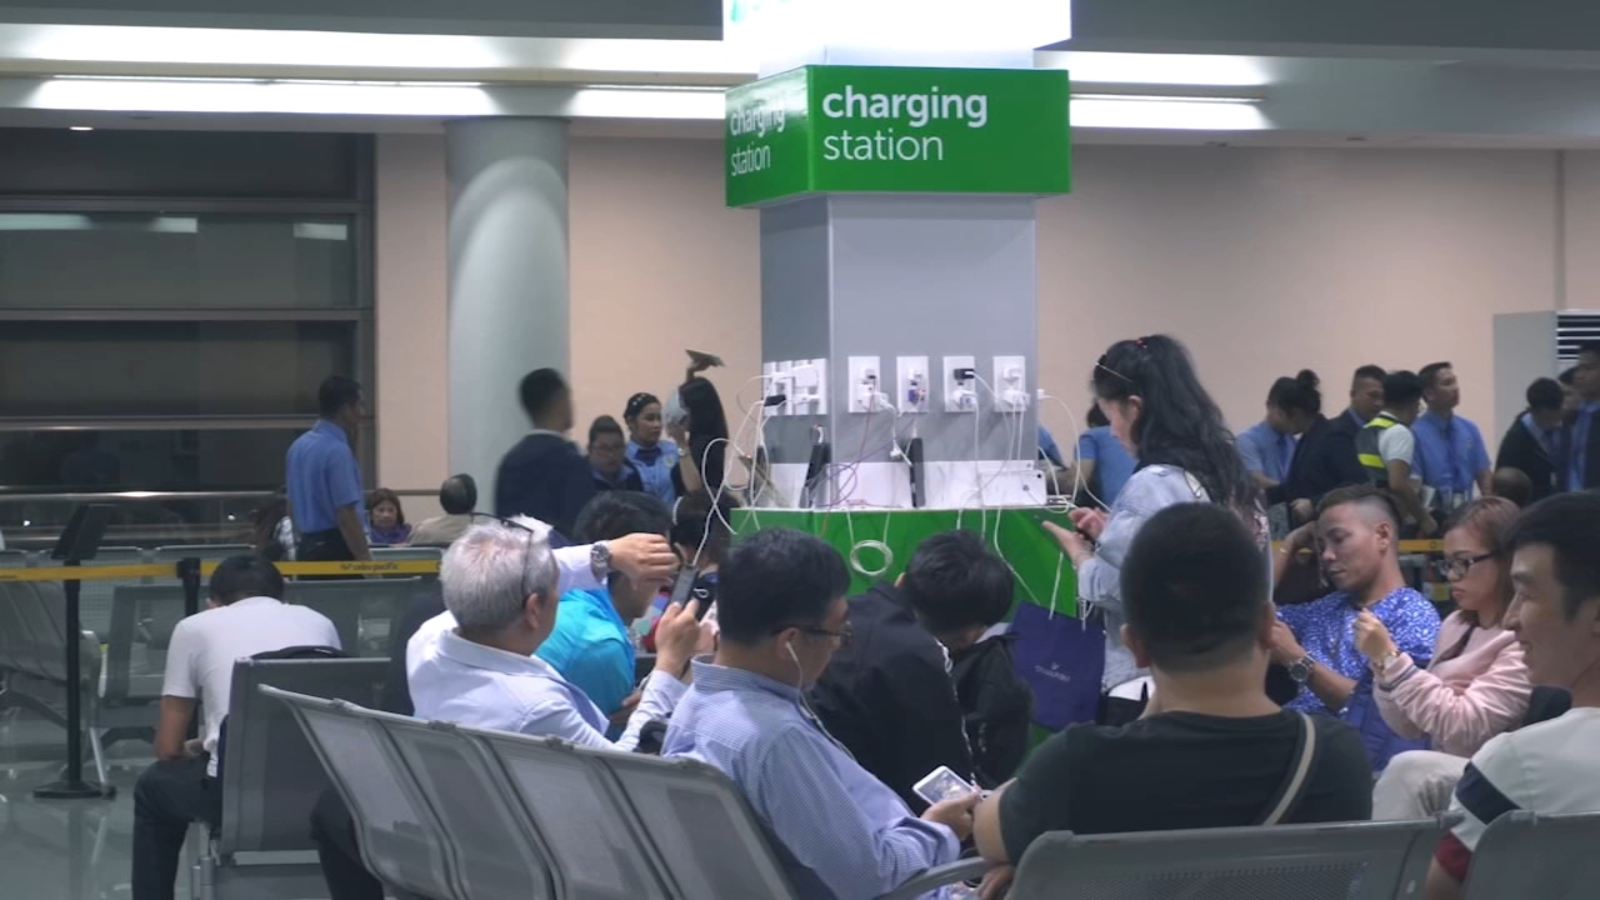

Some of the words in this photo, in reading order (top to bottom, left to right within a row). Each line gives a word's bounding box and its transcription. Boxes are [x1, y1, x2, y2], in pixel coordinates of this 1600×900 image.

[730, 103, 786, 137] charging
[822, 85, 988, 128] charging
[731, 143, 771, 176] station
[823, 128, 944, 162] station
